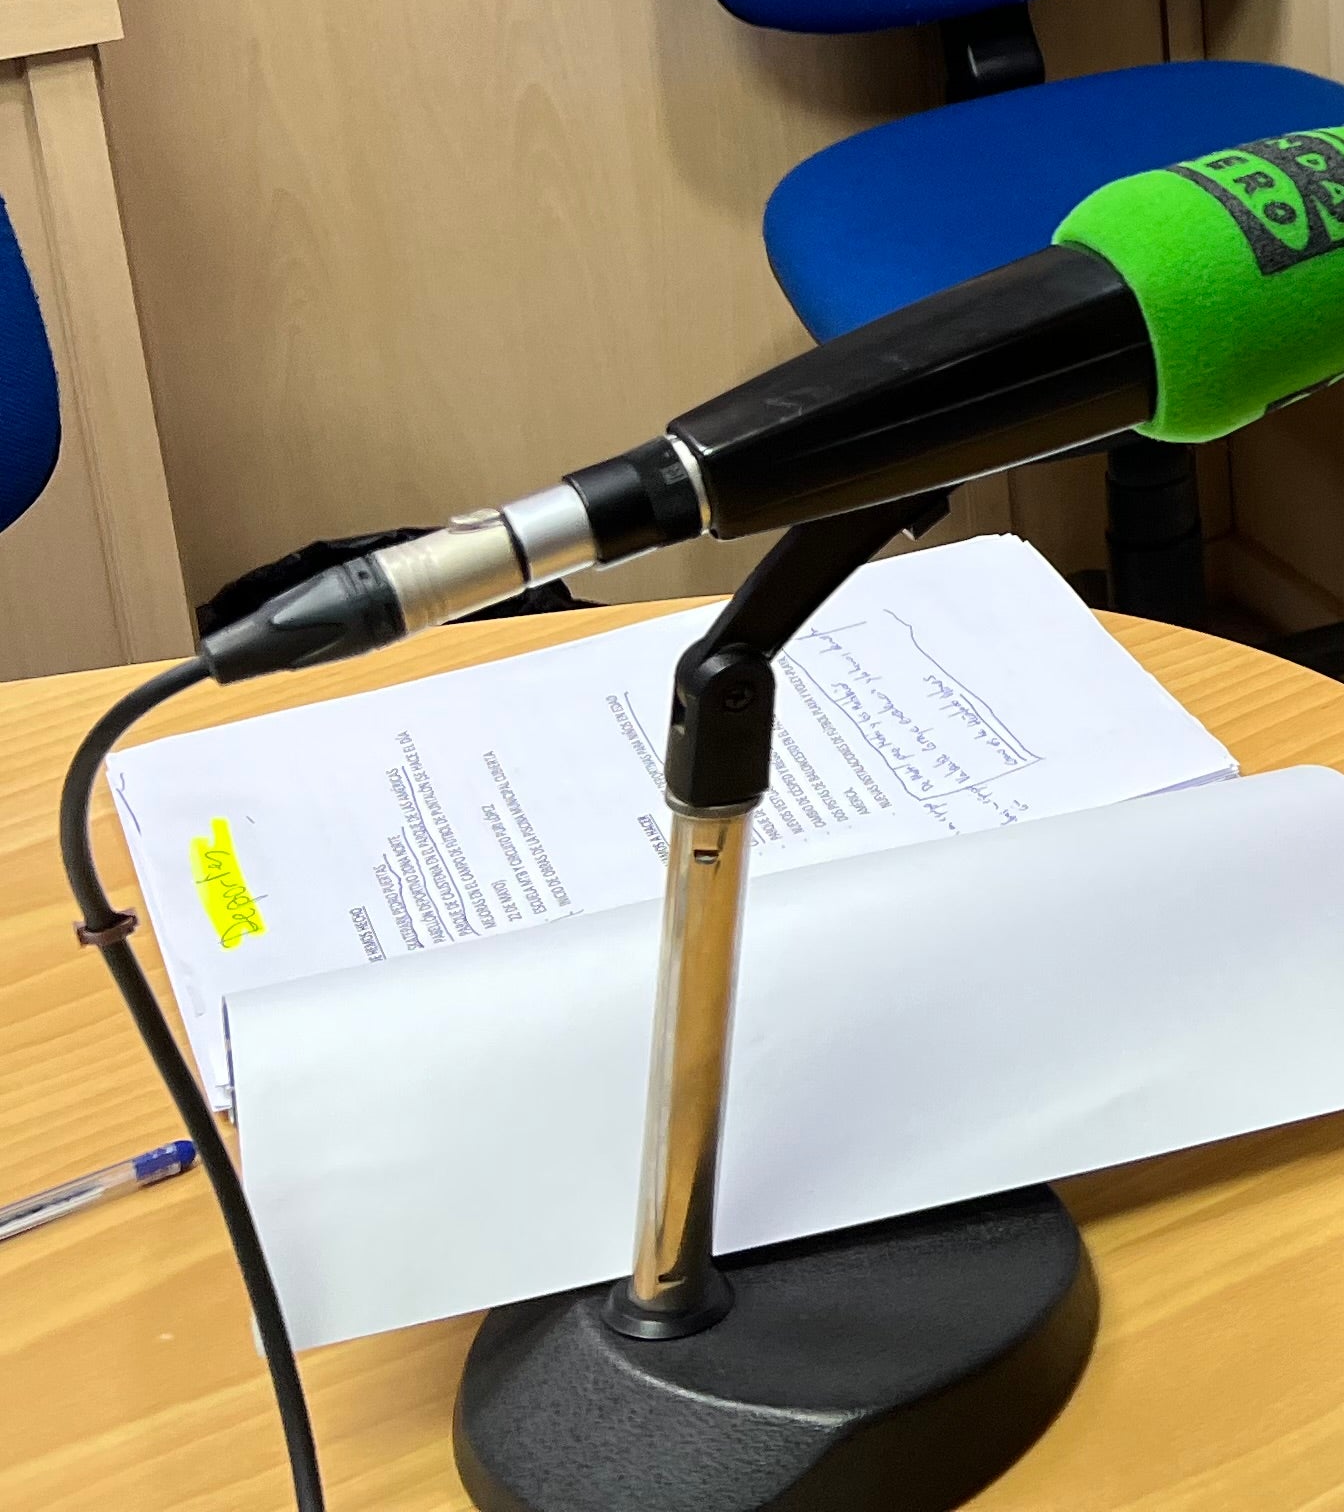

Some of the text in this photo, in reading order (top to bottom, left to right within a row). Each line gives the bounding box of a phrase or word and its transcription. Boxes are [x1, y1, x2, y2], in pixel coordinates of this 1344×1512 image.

[615, 711, 628, 722] EN
[782, 736, 795, 746] EN
[830, 734, 845, 745] DE
[402, 743, 416, 753] EL
[405, 751, 423, 772] HACE
[786, 745, 820, 782] BALONCESTO
[836, 743, 874, 786] INSTALACIONES
[811, 780, 826, 791] DE
[795, 795, 811, 806] DE
[817, 789, 840, 811] PISTAS
[866, 784, 892, 809] NUEVAS
[399, 801, 416, 813] LAS
[404, 812, 420, 823] DE
[432, 814, 448, 826] DE
[801, 804, 827, 828] CAMBIO
[830, 808, 849, 822] DOS
[779, 810, 805, 835] NUEVOS
[525, 835, 540, 846] LA
[447, 846, 463, 858] DE
[498, 836, 522, 867] CIRCUITO
[529, 844, 545, 856] DE
[397, 855, 416, 876] ZONA
[425, 854, 439, 866] EN
[534, 854, 556, 878] OBRAS
[452, 856, 474, 882] CAMPO
[372, 863, 395, 894] PUERTAS
[464, 879, 479, 890] EL
[545, 876, 562, 888] DE
[405, 874, 432, 912] DEPORTIVO
[467, 888, 483, 900] EN
[385, 892, 406, 916] PEDRO
[444, 899, 460, 911] DE
[523, 885, 547, 915] ESCUELA
[472, 898, 496, 929] MEJORAS
[502, 902, 518, 913] DE
[349, 907, 368, 932] HECHO
[507, 911, 523, 922] 22
